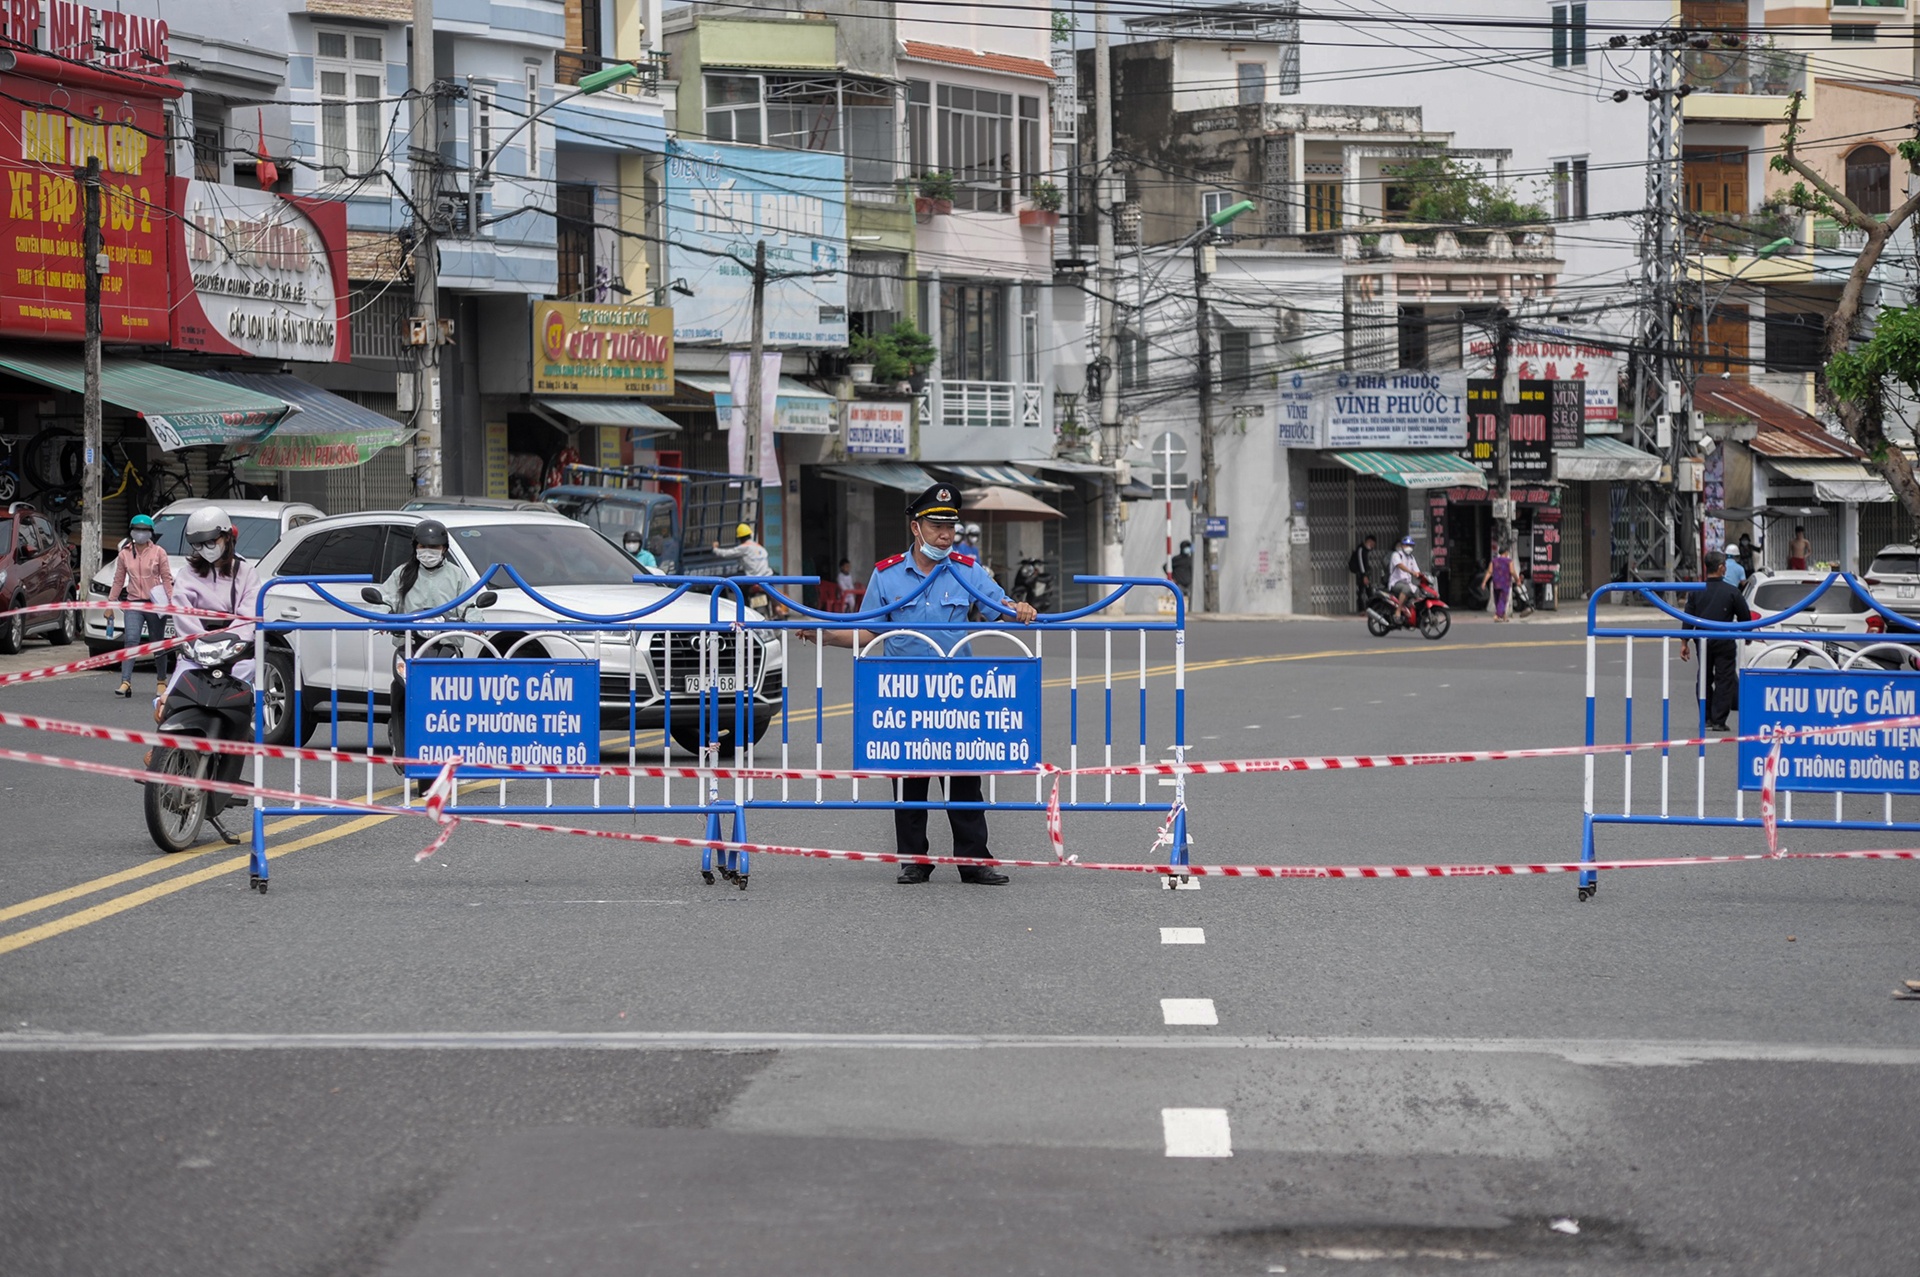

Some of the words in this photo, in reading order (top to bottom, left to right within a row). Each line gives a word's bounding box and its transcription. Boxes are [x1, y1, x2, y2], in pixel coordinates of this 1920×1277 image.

[51, 1, 95, 60] NHA
[101, 9, 170, 75] TRANG
[67, 106, 108, 171] TRẢ
[107, 116, 148, 176] GÓP
[669, 149, 701, 183] ĐIỆN
[704, 150, 724, 182] TỬ
[8, 170, 33, 220] XE
[38, 174, 77, 232] ĐẠP
[140, 187, 152, 233] 2
[690, 178, 755, 235] TIẾN
[16, 234, 39, 253] CHUYÊN
[41, 238, 55, 255] MUA
[56, 235, 70, 257] BÁN
[138, 249, 152, 265] THAO
[17, 268, 32, 285] THAY
[34, 266, 46, 286] THẾ
[46, 271, 61, 287] LINH
[62, 271, 76, 292] KIỆN
[103, 276, 111, 292] XE
[193, 273, 226, 291] CHUYÊN
[226, 279, 251, 295] CUNG
[253, 278, 270, 297] CẤP
[281, 282, 292, 299] VÀ
[229, 306, 246, 338] CÁC
[246, 314, 265, 348] LOẠI
[266, 308, 280, 342] HẢI
[281, 310, 298, 343] SẢN
[315, 313, 334, 348] SỐNG
[565, 325, 605, 361] CÁT
[1355, 374, 1387, 389] NHÀ
[1392, 373, 1440, 389] THUỐC
[1286, 401, 1308, 419] VĨNH
[1335, 391, 1380, 414] VĨNH
[1386, 389, 1448, 414] PHƯỚC
[1453, 396, 1461, 413] I
[1553, 391, 1579, 408] MỤN
[861, 408, 877, 421] THANH
[878, 406, 889, 421] TIẾN
[849, 423, 873, 443] CHUYÊN
[875, 424, 892, 443] HÀNG
[1278, 421, 1309, 439] PHƯỚC
[258, 437, 278, 467] HẢI
[278, 436, 297, 467] SẢN
[301, 437, 314, 467] ÁI
[431, 676, 472, 701] KHU
[479, 674, 519, 705] VỰC
[526, 669, 573, 701] CẤM
[878, 674, 919, 698] KHU
[925, 672, 964, 702] VỰC
[970, 667, 1016, 698] CẤM
[1765, 687, 1809, 713] KHU
[1816, 686, 1858, 718] VỰC
[1865, 681, 1916, 715] CẤM
[425, 709, 461, 733] CÁC
[466, 712, 537, 733] PHƯƠNG
[542, 710, 581, 736] TIỆN
[872, 707, 906, 729] CÁC
[911, 708, 980, 729] PHƯƠNG
[985, 707, 1023, 733] TIỆN
[1802, 724, 1876, 747] PHƯƠNG
[419, 745, 454, 763] GIAO
[458, 742, 507, 765] THÔNG
[511, 741, 562, 765] ĐƯỜNG
[566, 742, 587, 765] BỘ
[866, 741, 900, 760] GIAO
[904, 738, 951, 760] THÔNG
[955, 737, 1006, 761] ĐƯỜNG
[1010, 738, 1029, 764] BỘ
[1794, 754, 1846, 779] THÔNG
[1850, 753, 1905, 780] ĐƯỜNG
